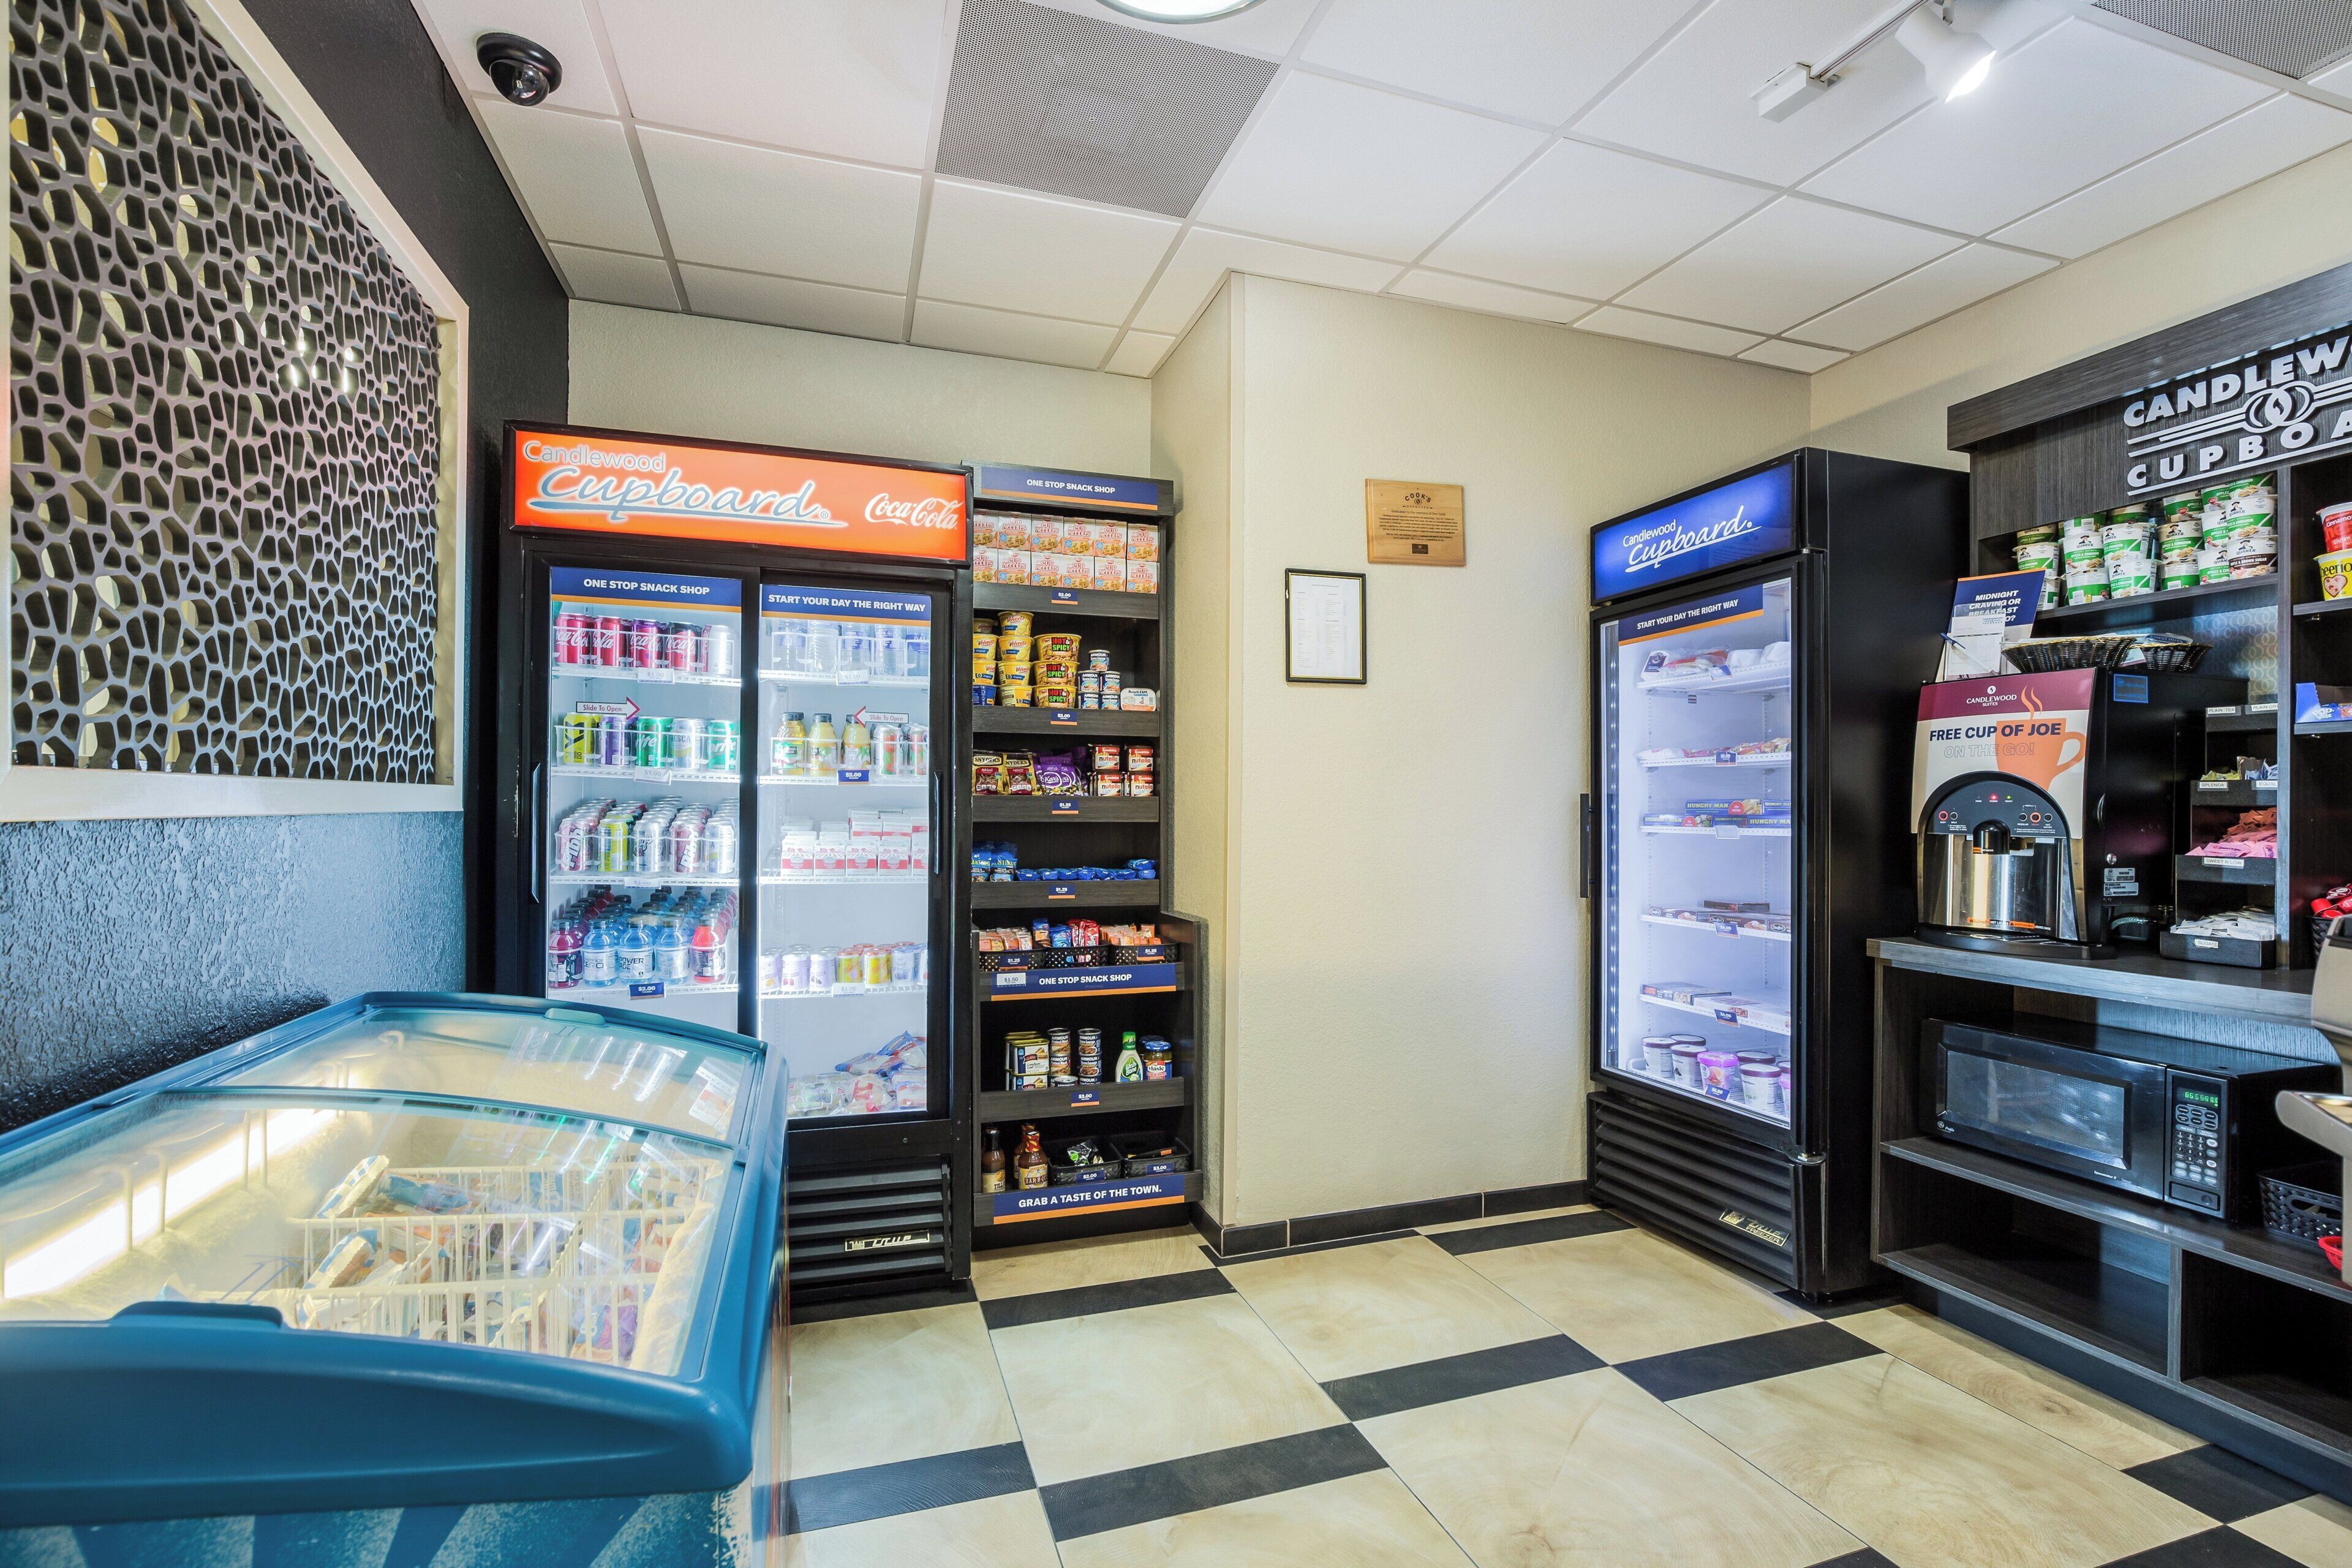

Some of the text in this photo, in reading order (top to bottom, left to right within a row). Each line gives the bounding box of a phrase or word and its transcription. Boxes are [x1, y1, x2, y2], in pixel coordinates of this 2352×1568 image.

[2124, 336, 2352, 427] CANDLEW
[524, 442, 665, 472] Candlewood
[1066, 483, 1093, 492] SNACK
[1094, 485, 1115, 494] SHOP
[1404, 492, 1431, 503] COOK'S
[864, 492, 964, 530] Coca-Cola
[1623, 519, 1676, 548] Candlewood
[2320, 562, 2352, 577] heerio
[583, 578, 710, 595] ONE STOP SNACK SHOP
[768, 594, 926, 612] START YOUR DAY THE RIGHT WAY
[1975, 590, 2019, 601] MIDNIGHT
[1968, 606, 2018, 617] BREAKFAST
[1969, 600, 2007, 609] CRAVING
[1637, 598, 1739, 630] START YOUR DAY THE RIGHT WAY
[1966, 693, 2017, 705] CANDLEWOOD
[606, 705, 622, 714] Open
[1929, 723, 2062, 742] FREE CUP OF JOE
[1943, 742, 2035, 759] ON THE GO!
[1080, 974, 1109, 983] SNACK
[1109, 973, 1132, 982] SHOP
[1126, 1067, 1137, 1076] Bone
[1018, 1184, 1162, 1208] GRAB A TASTE OF THE TOWN.
[1745, 1225, 1781, 1244] FREEZER
